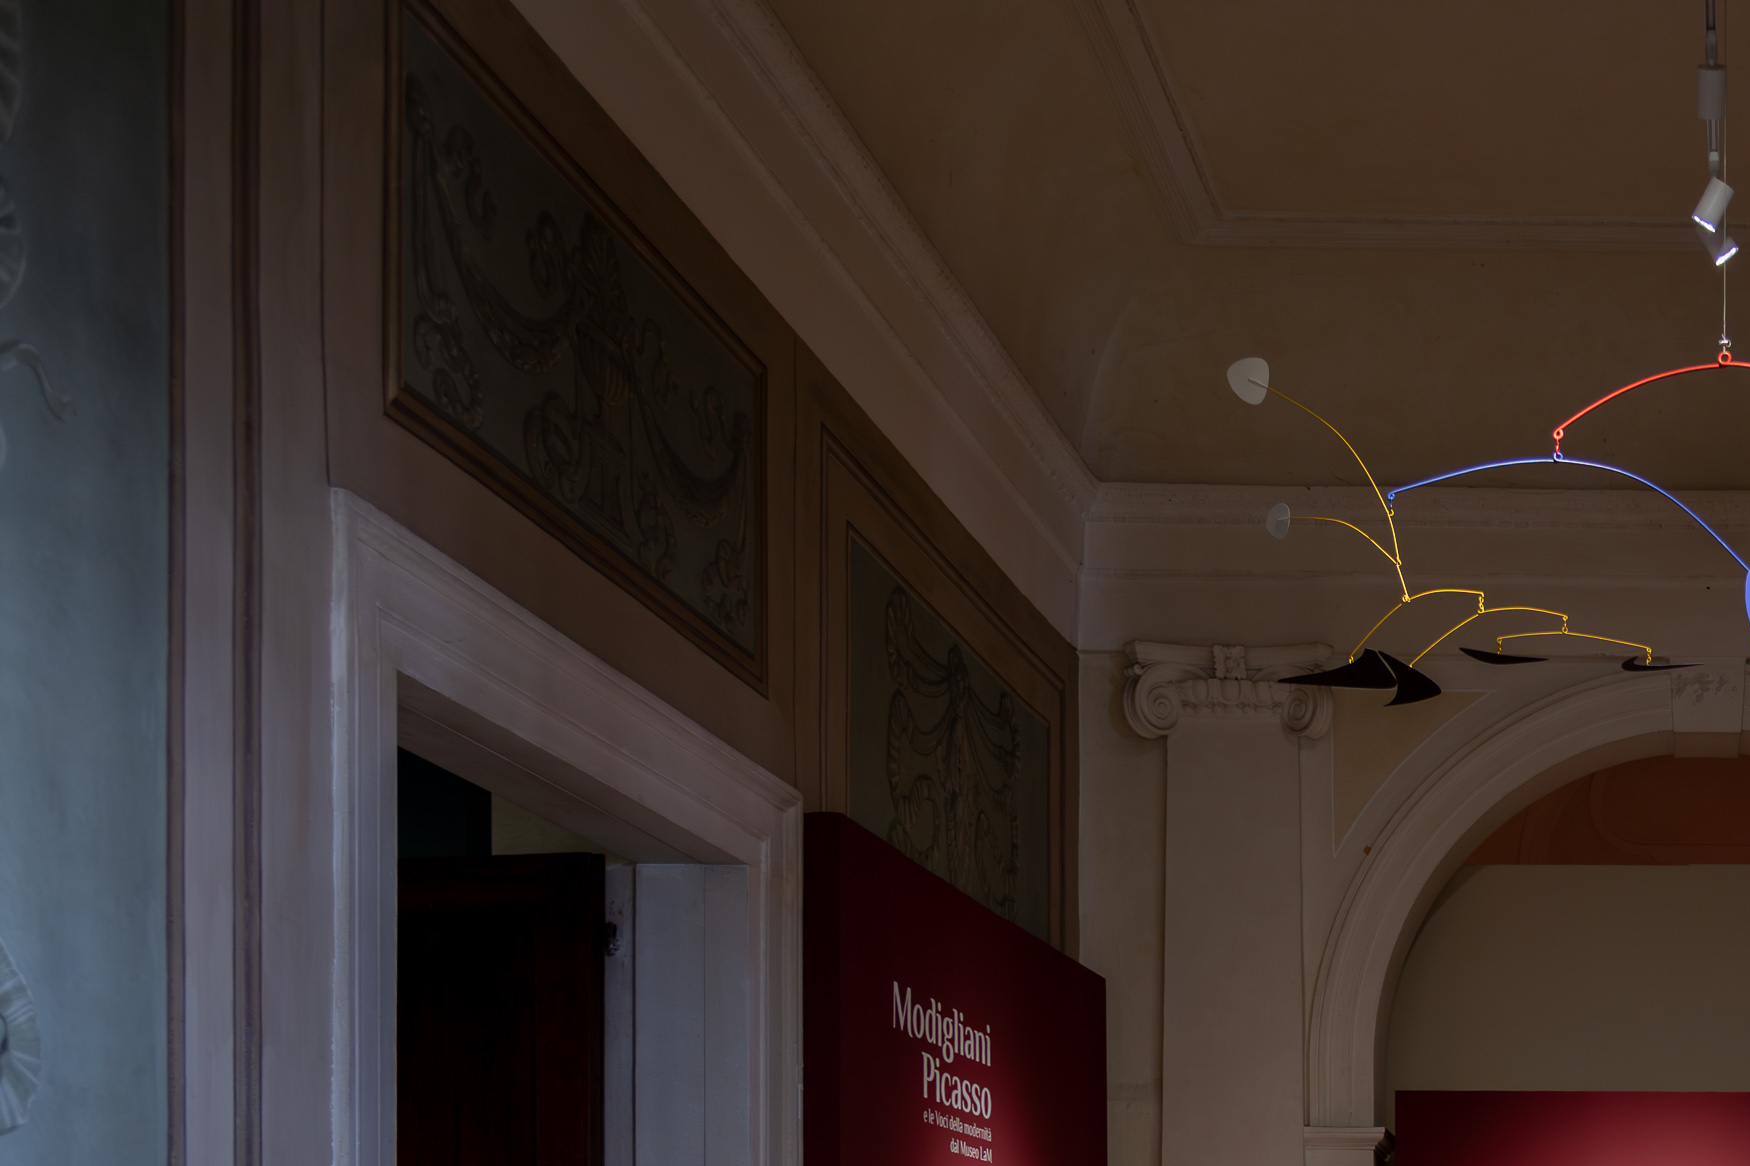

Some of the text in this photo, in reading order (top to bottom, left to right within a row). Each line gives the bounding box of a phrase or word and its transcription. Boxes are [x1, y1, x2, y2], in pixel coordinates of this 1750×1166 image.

[893, 981, 991, 1066] Modigliani
[922, 1052, 992, 1119] Picasso
[924, 1109, 991, 1142] e le Voci della modernità
[950, 1138, 992, 1163] dal Museo LaM
